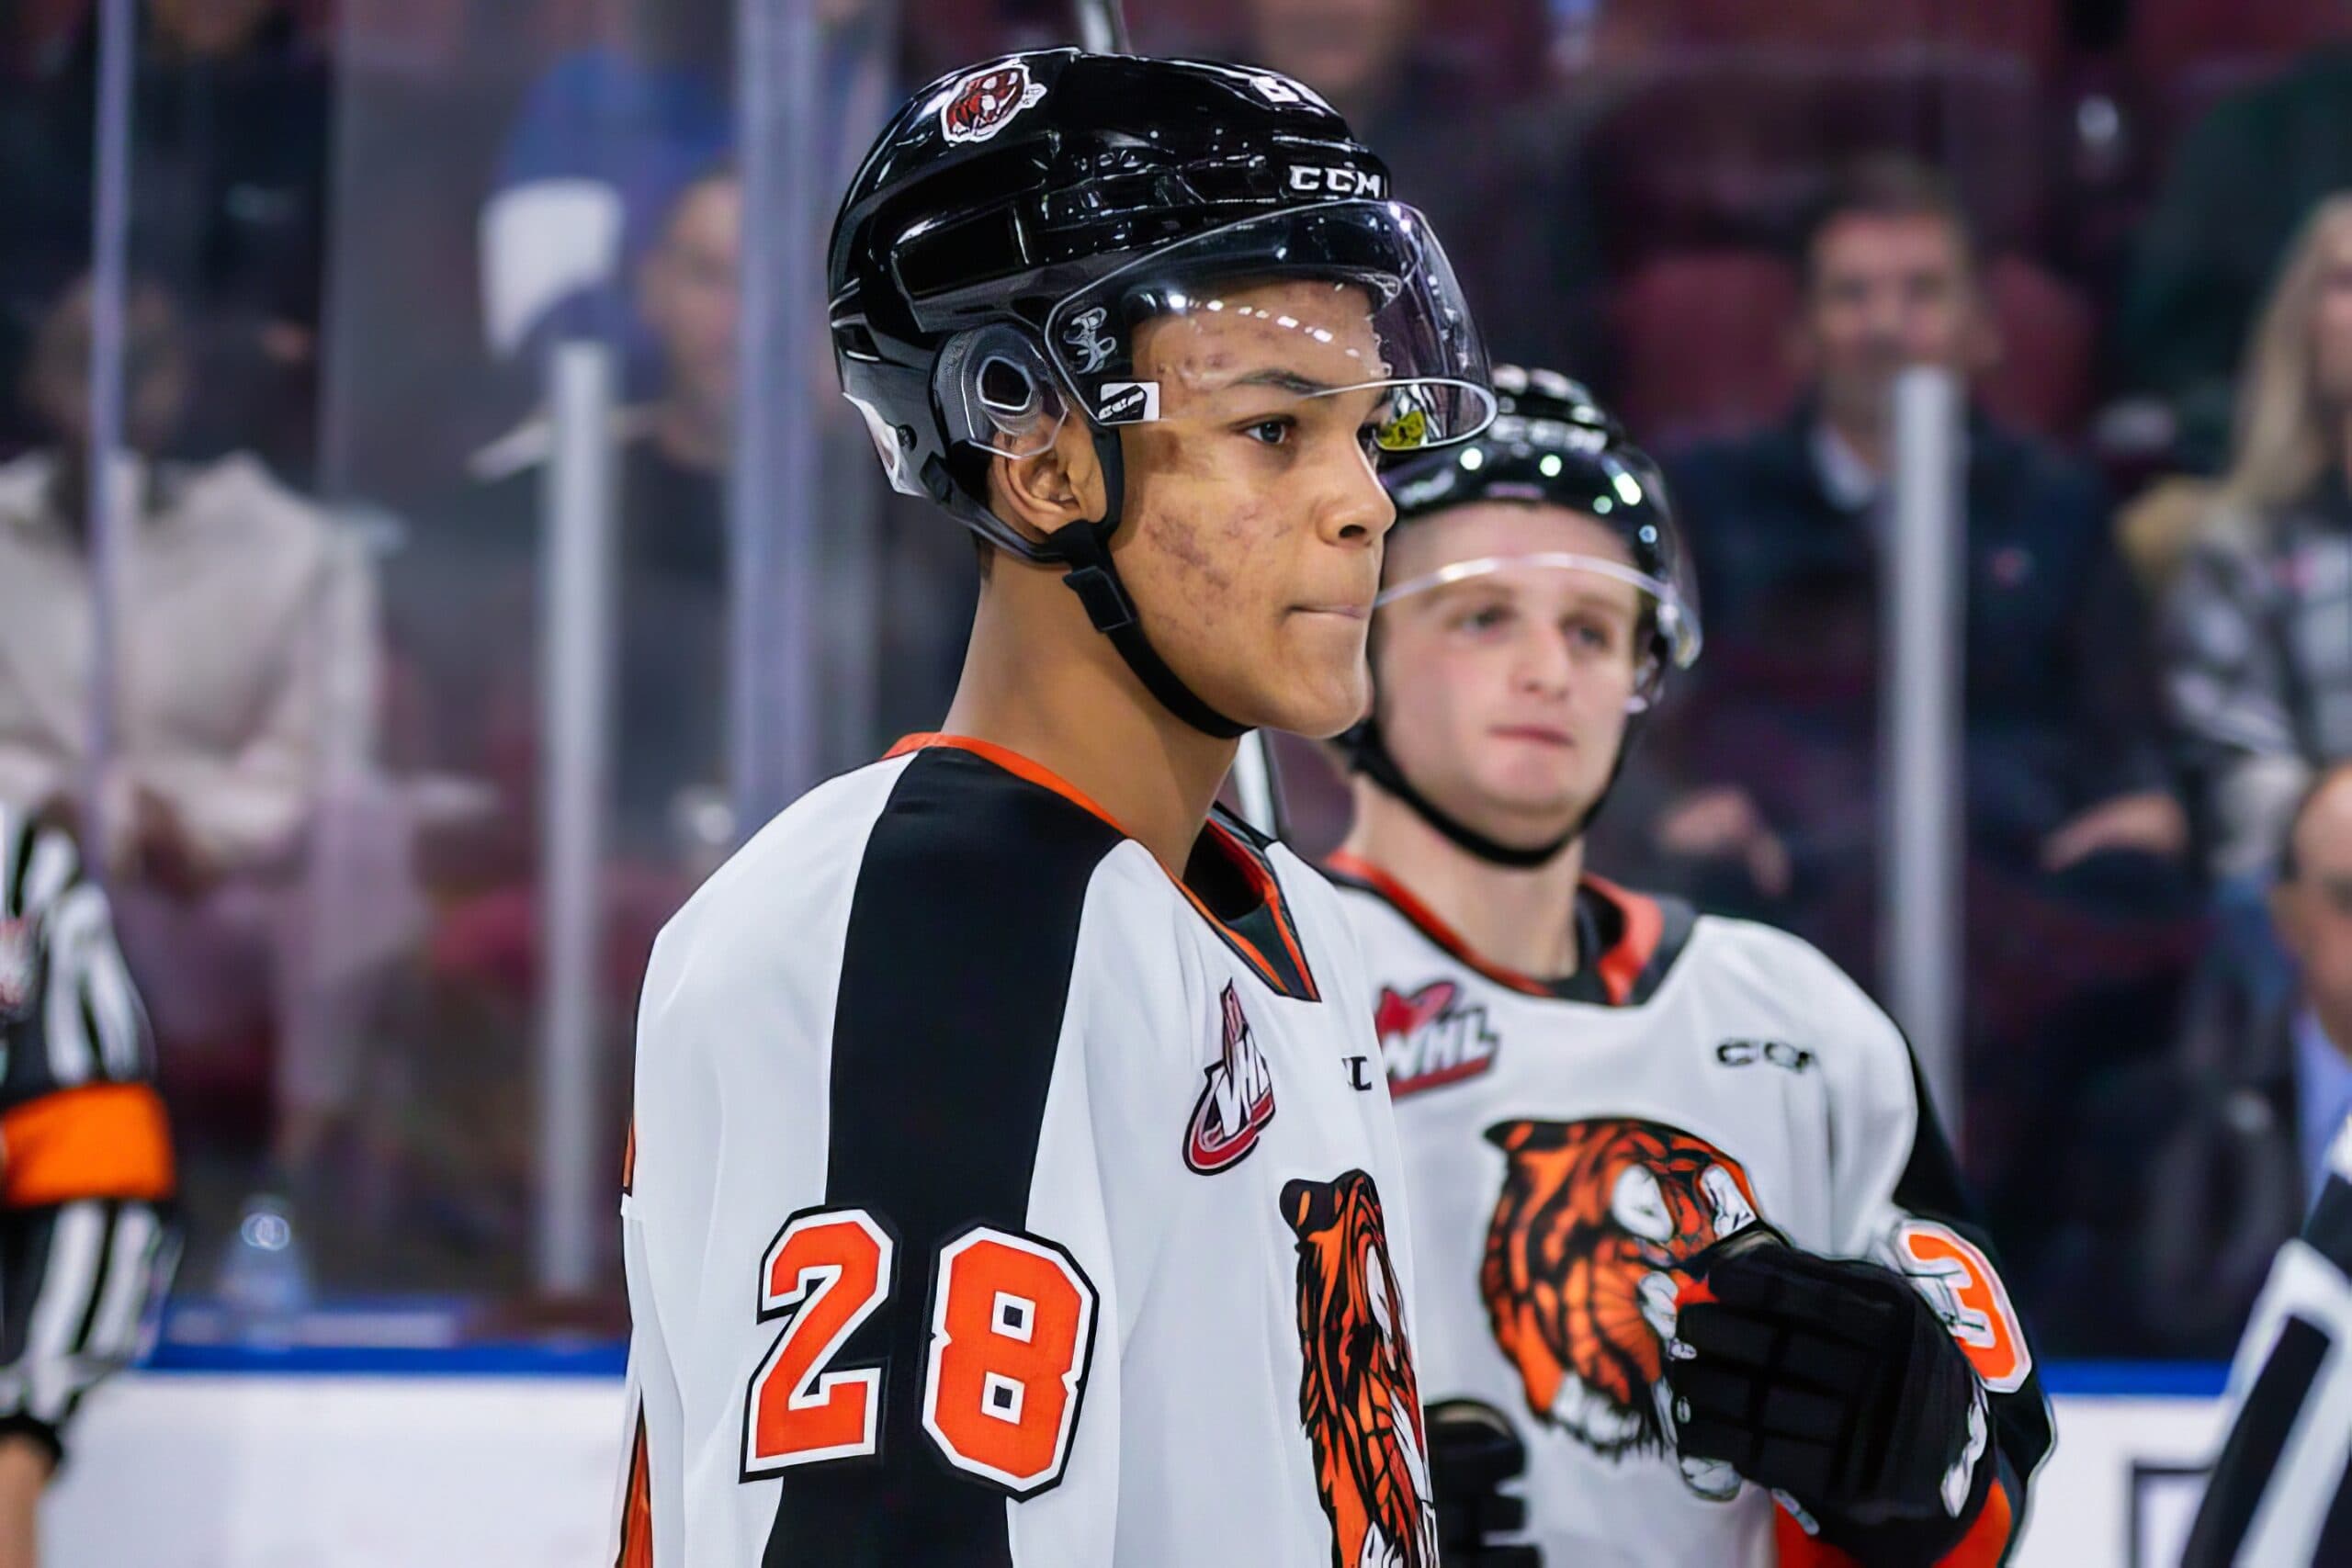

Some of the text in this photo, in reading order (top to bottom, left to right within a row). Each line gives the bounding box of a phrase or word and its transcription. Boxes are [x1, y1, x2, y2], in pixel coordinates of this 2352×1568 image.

[1288, 164, 1381, 199] CCM
[739, 1205, 1100, 1504] 28
[1897, 1218, 2033, 1394] 3
